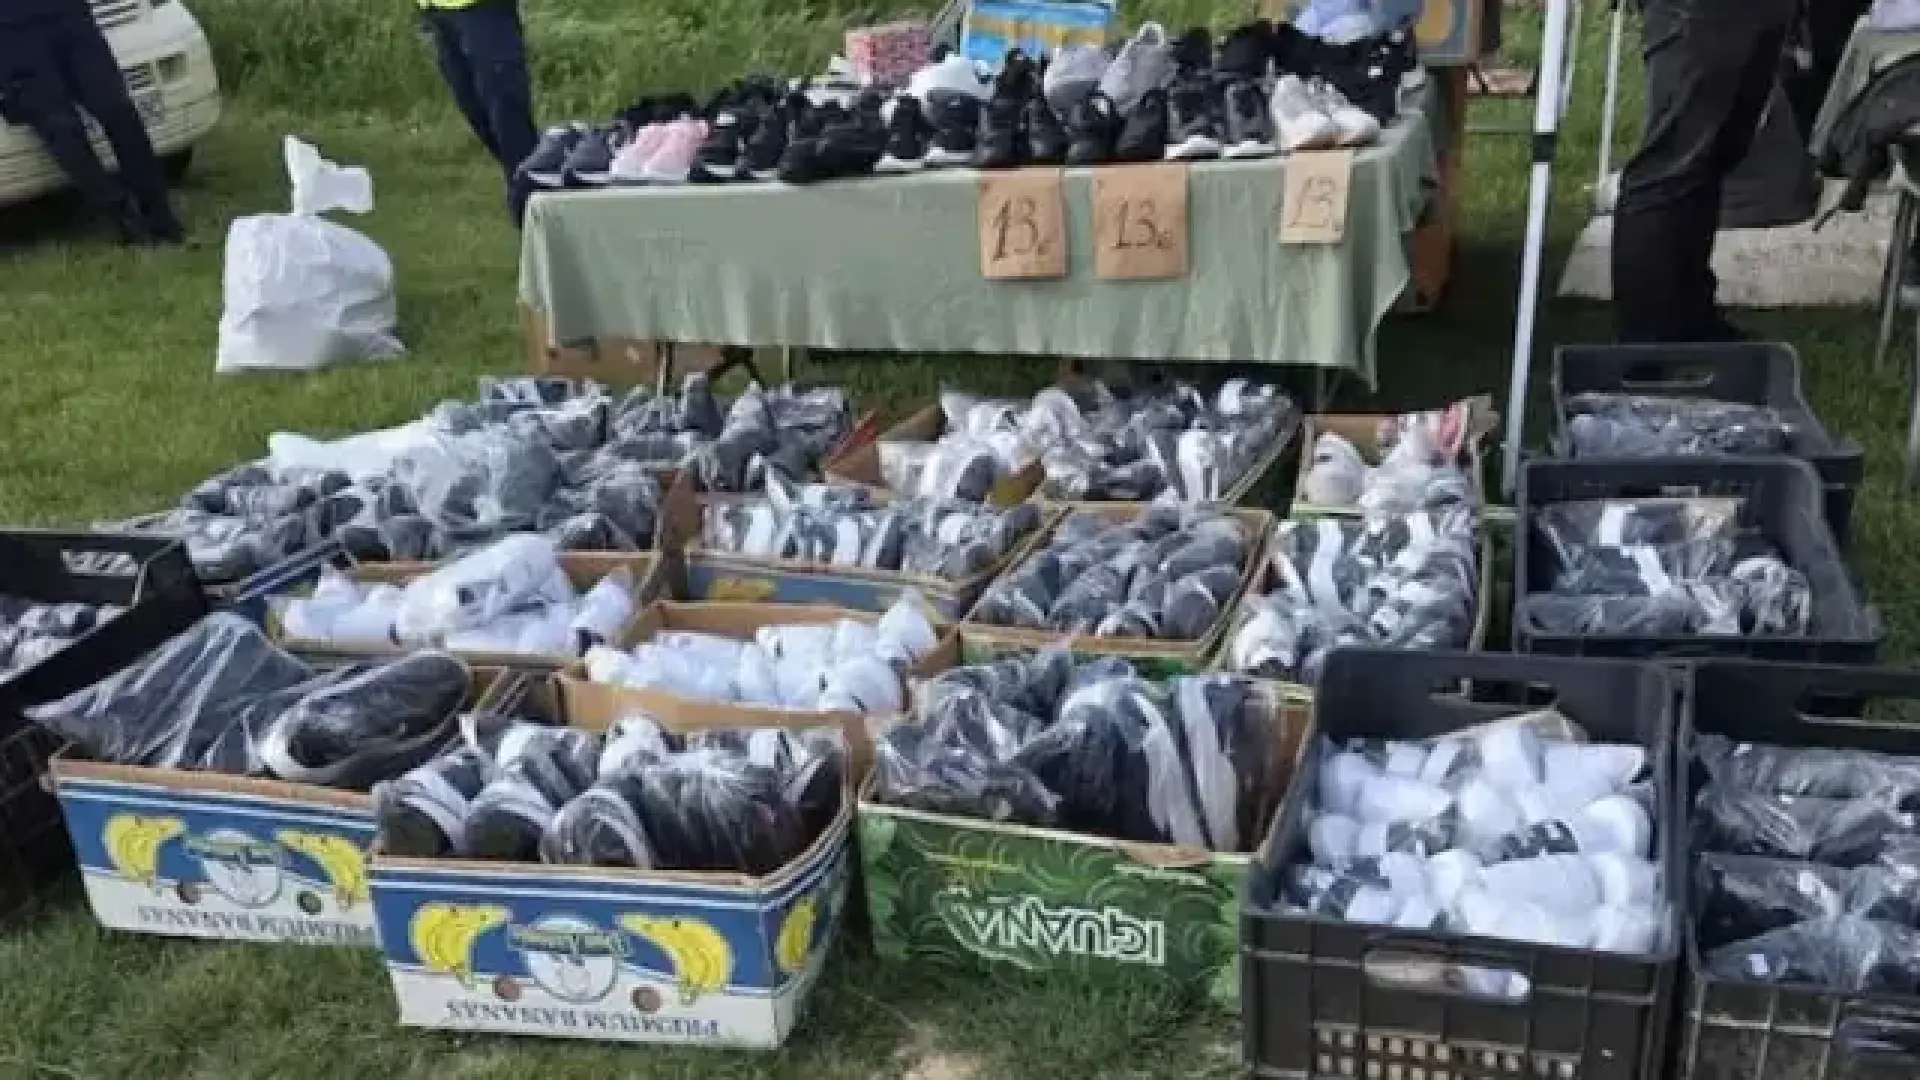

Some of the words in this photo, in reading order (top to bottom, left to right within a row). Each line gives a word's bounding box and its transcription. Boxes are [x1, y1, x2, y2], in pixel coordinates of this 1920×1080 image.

[945, 895, 1165, 961] IGUANA
[447, 1002, 577, 1028] BANANAS
[586, 1010, 719, 1037] PREMIUM
